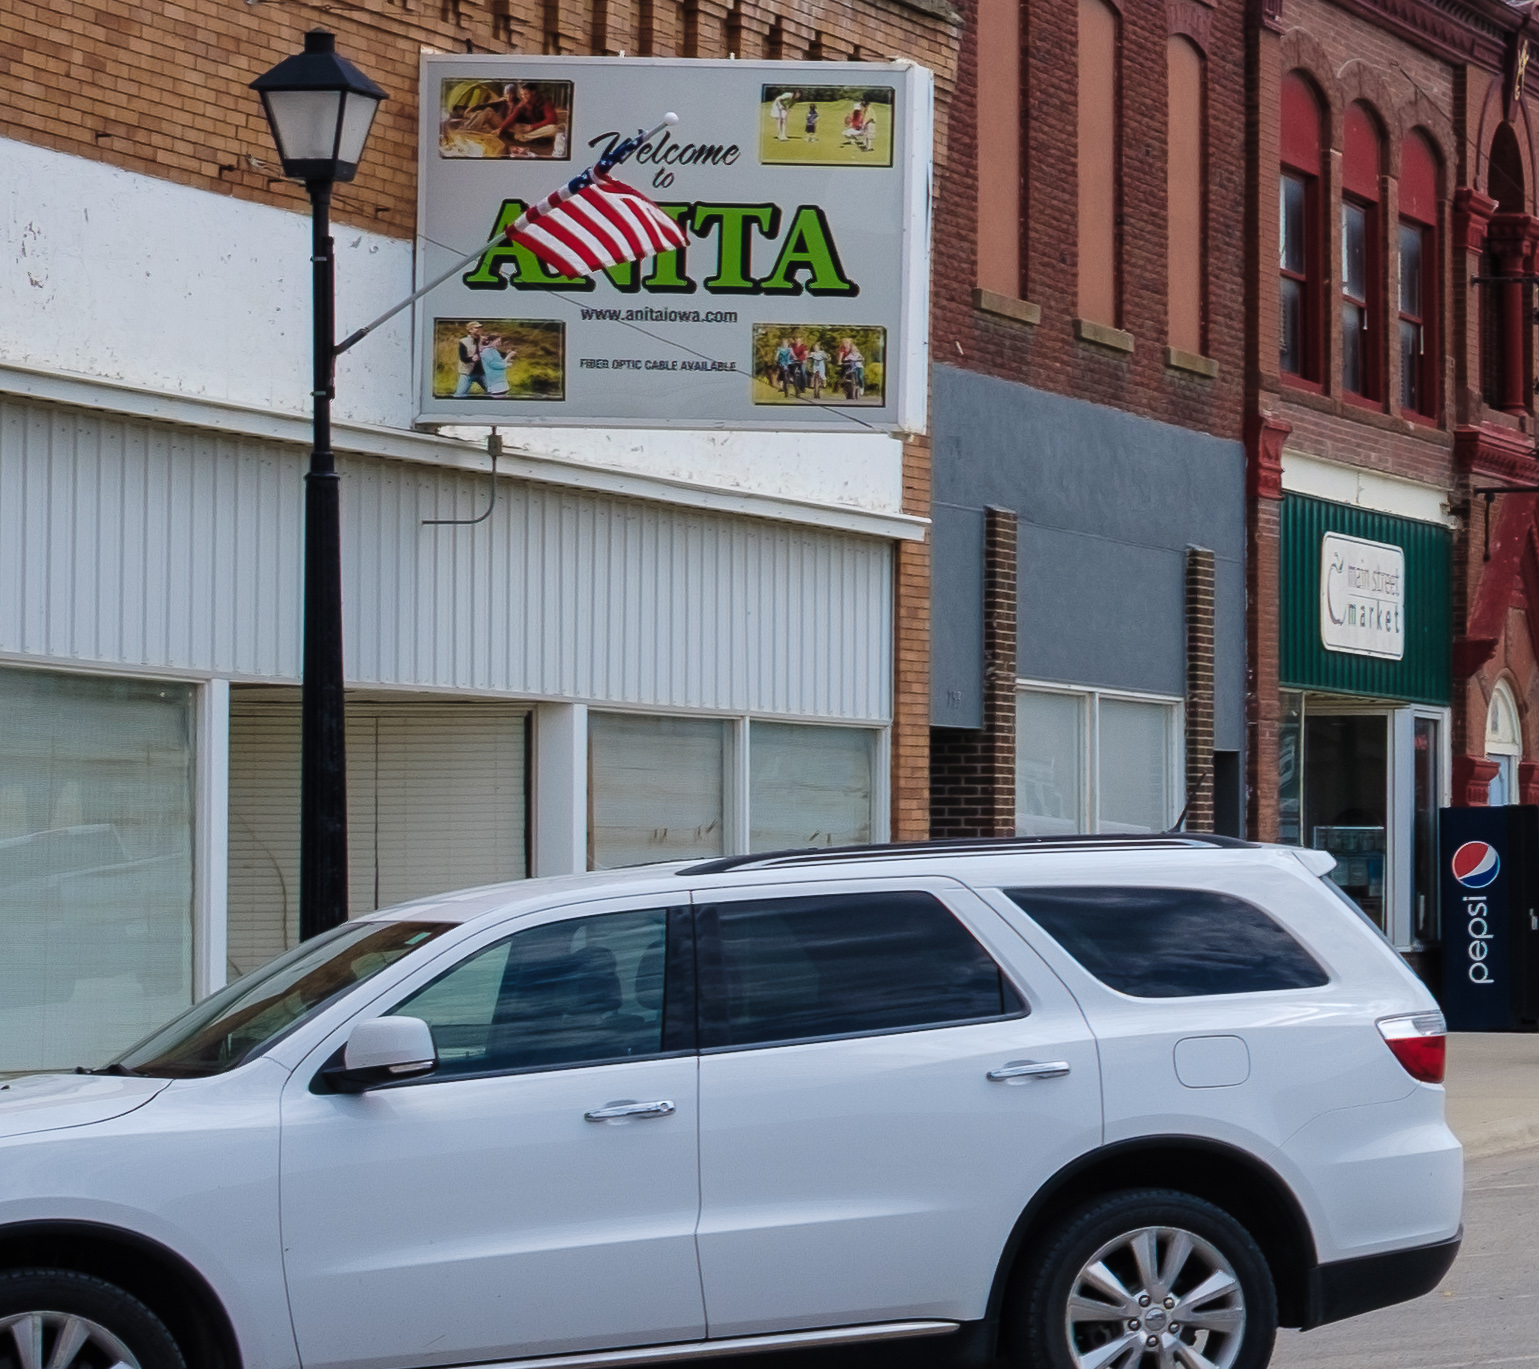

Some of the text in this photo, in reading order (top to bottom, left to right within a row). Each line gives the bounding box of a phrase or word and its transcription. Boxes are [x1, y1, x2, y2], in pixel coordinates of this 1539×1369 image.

[652, 166, 675, 189] to
[463, 198, 860, 297] AITA
[580, 306, 738, 323] www.anitaiowa.com
[579, 358, 737, 372] FIBER OPTIC CABLE AVAILABLE
[1347, 558, 1400, 597] main street
[1347, 599, 1400, 634] market
[1462, 895, 1495, 984] pepsi
